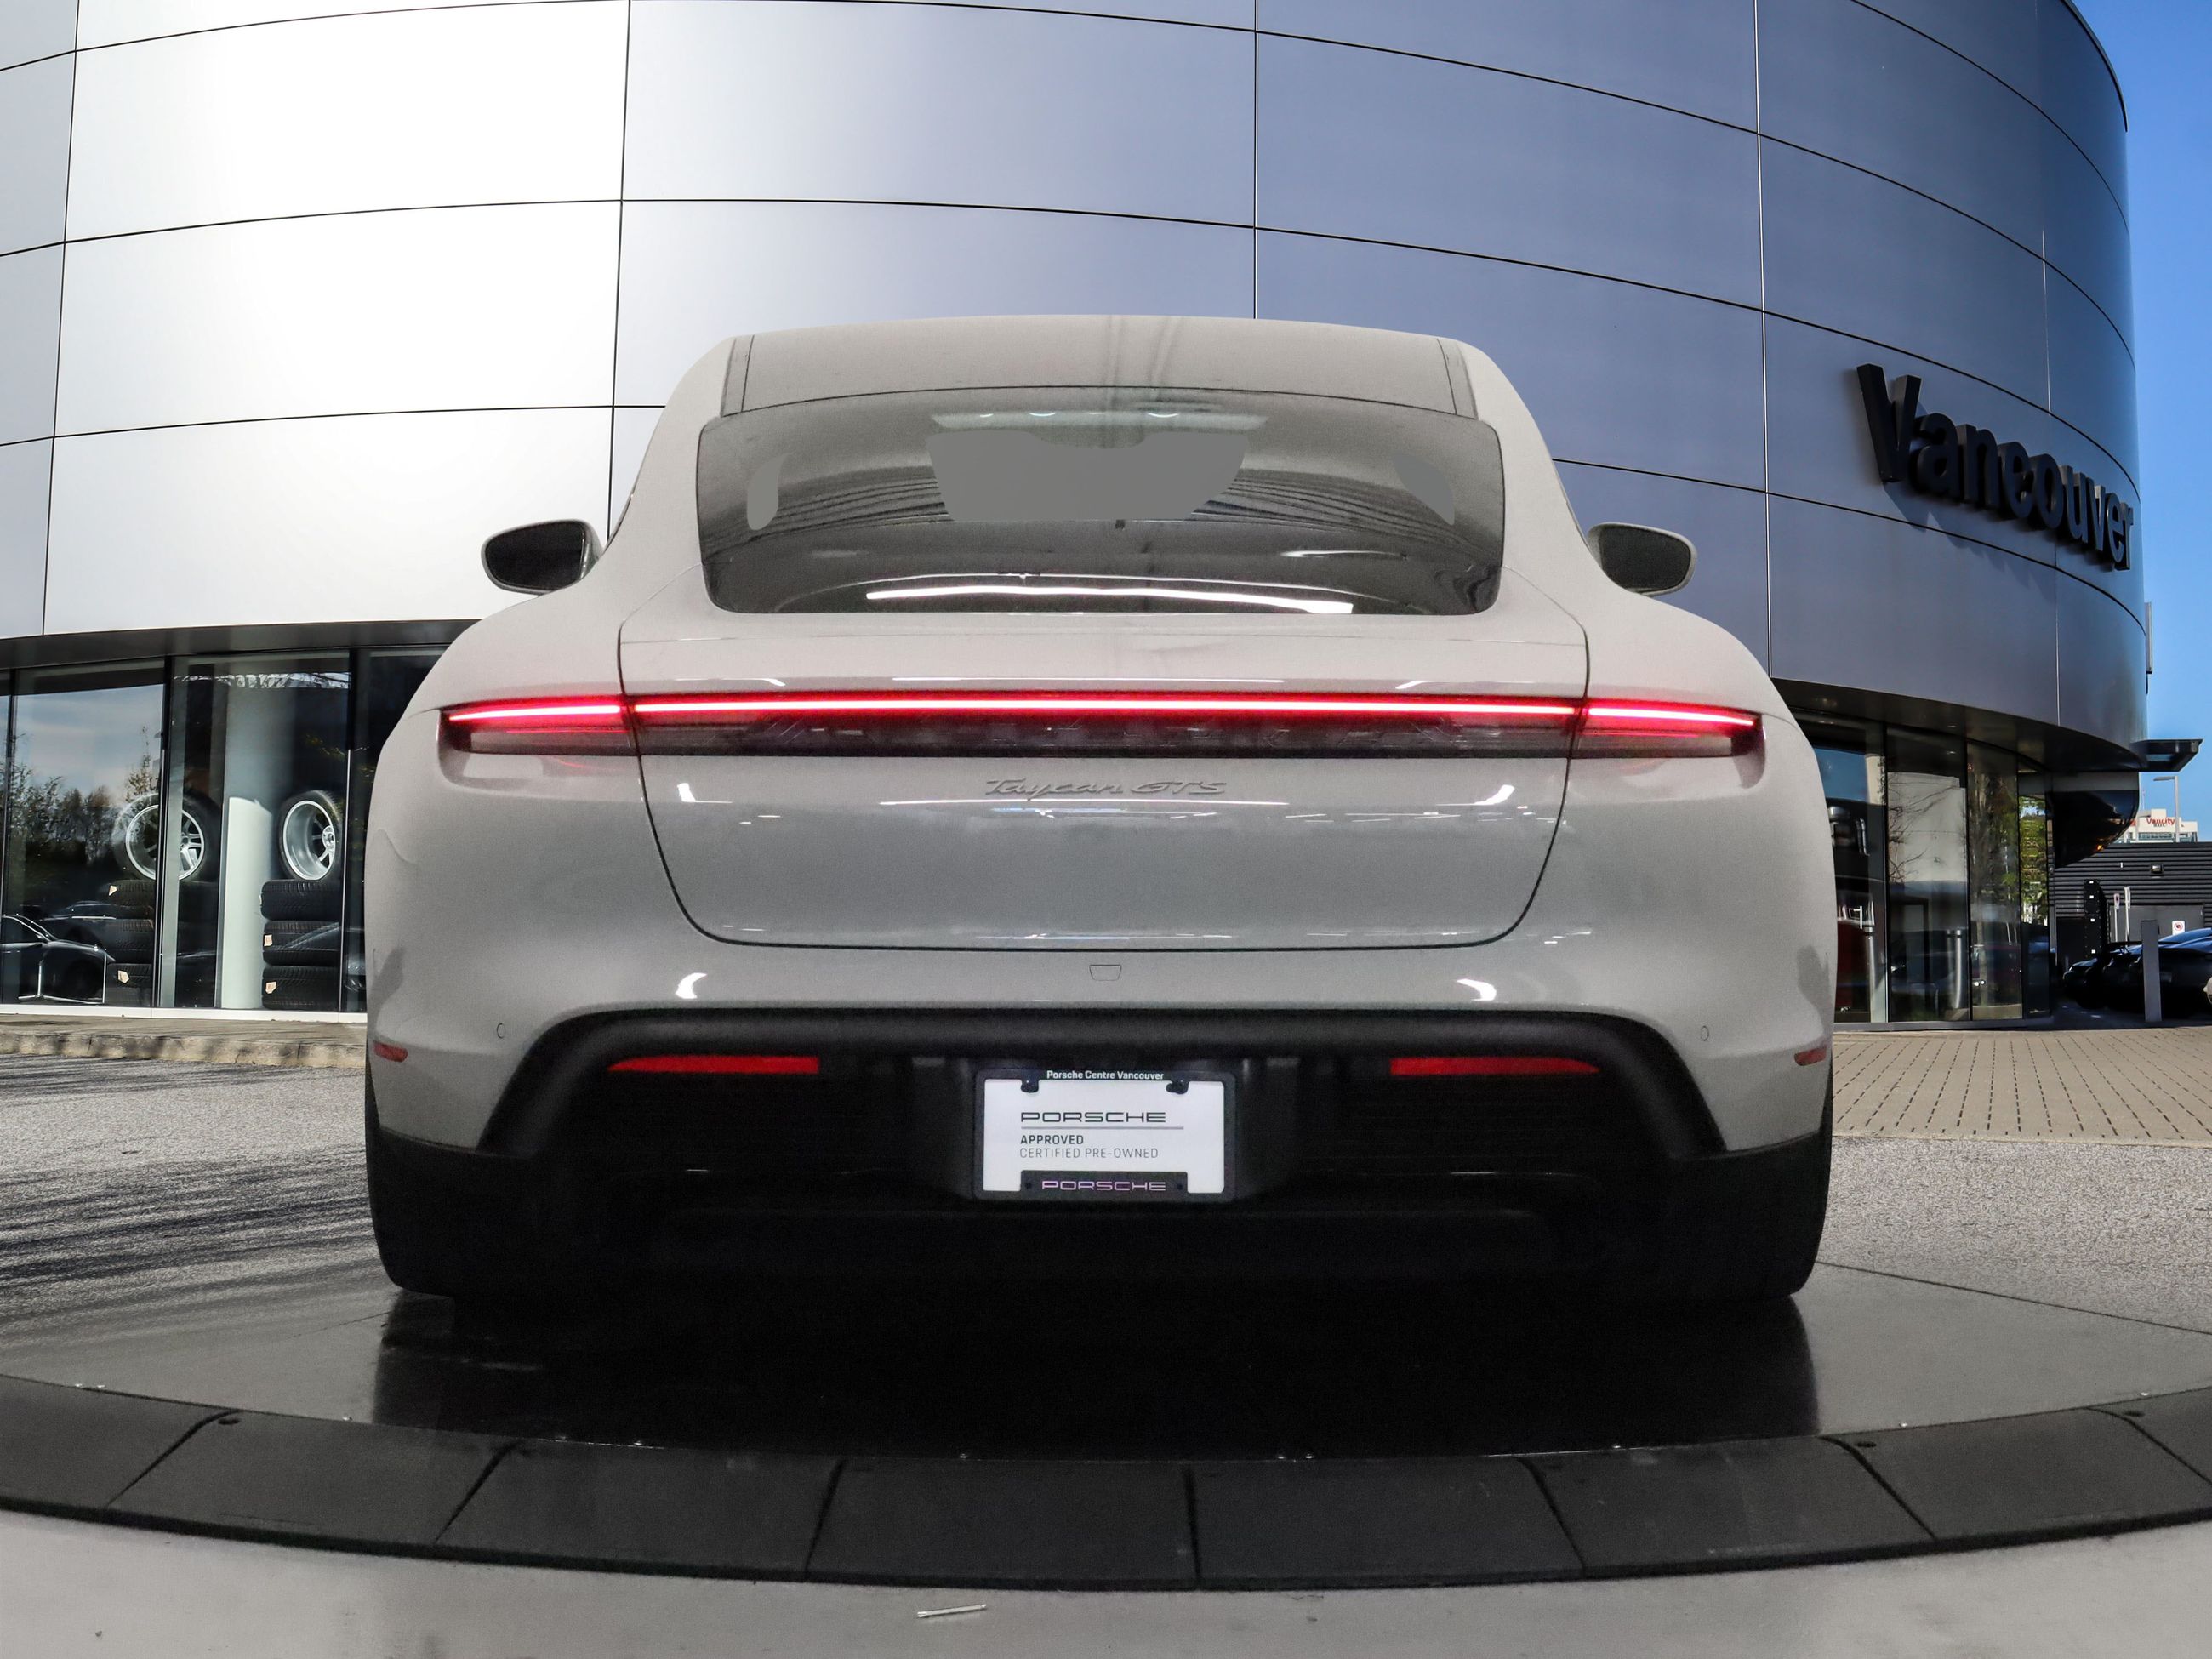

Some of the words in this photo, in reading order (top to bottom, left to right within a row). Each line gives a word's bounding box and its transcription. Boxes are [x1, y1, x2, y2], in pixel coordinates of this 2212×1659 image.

[1856, 363, 2134, 571] Vancouver
[985, 778, 1123, 801] Taycan
[1131, 781, 1227, 795] GTS
[1046, 1070, 1083, 1079] Porsche
[1085, 1070, 1115, 1079] Centre
[1117, 1071, 1164, 1080] Vancouver
[1021, 1112, 1166, 1122] PORSCHE
[1020, 1134, 1084, 1145] APPROVED
[1020, 1148, 1080, 1158] CERTIFIED
[1085, 1148, 1159, 1159] PRE-OWNED
[1042, 1180, 1166, 1191] PORSCHE
